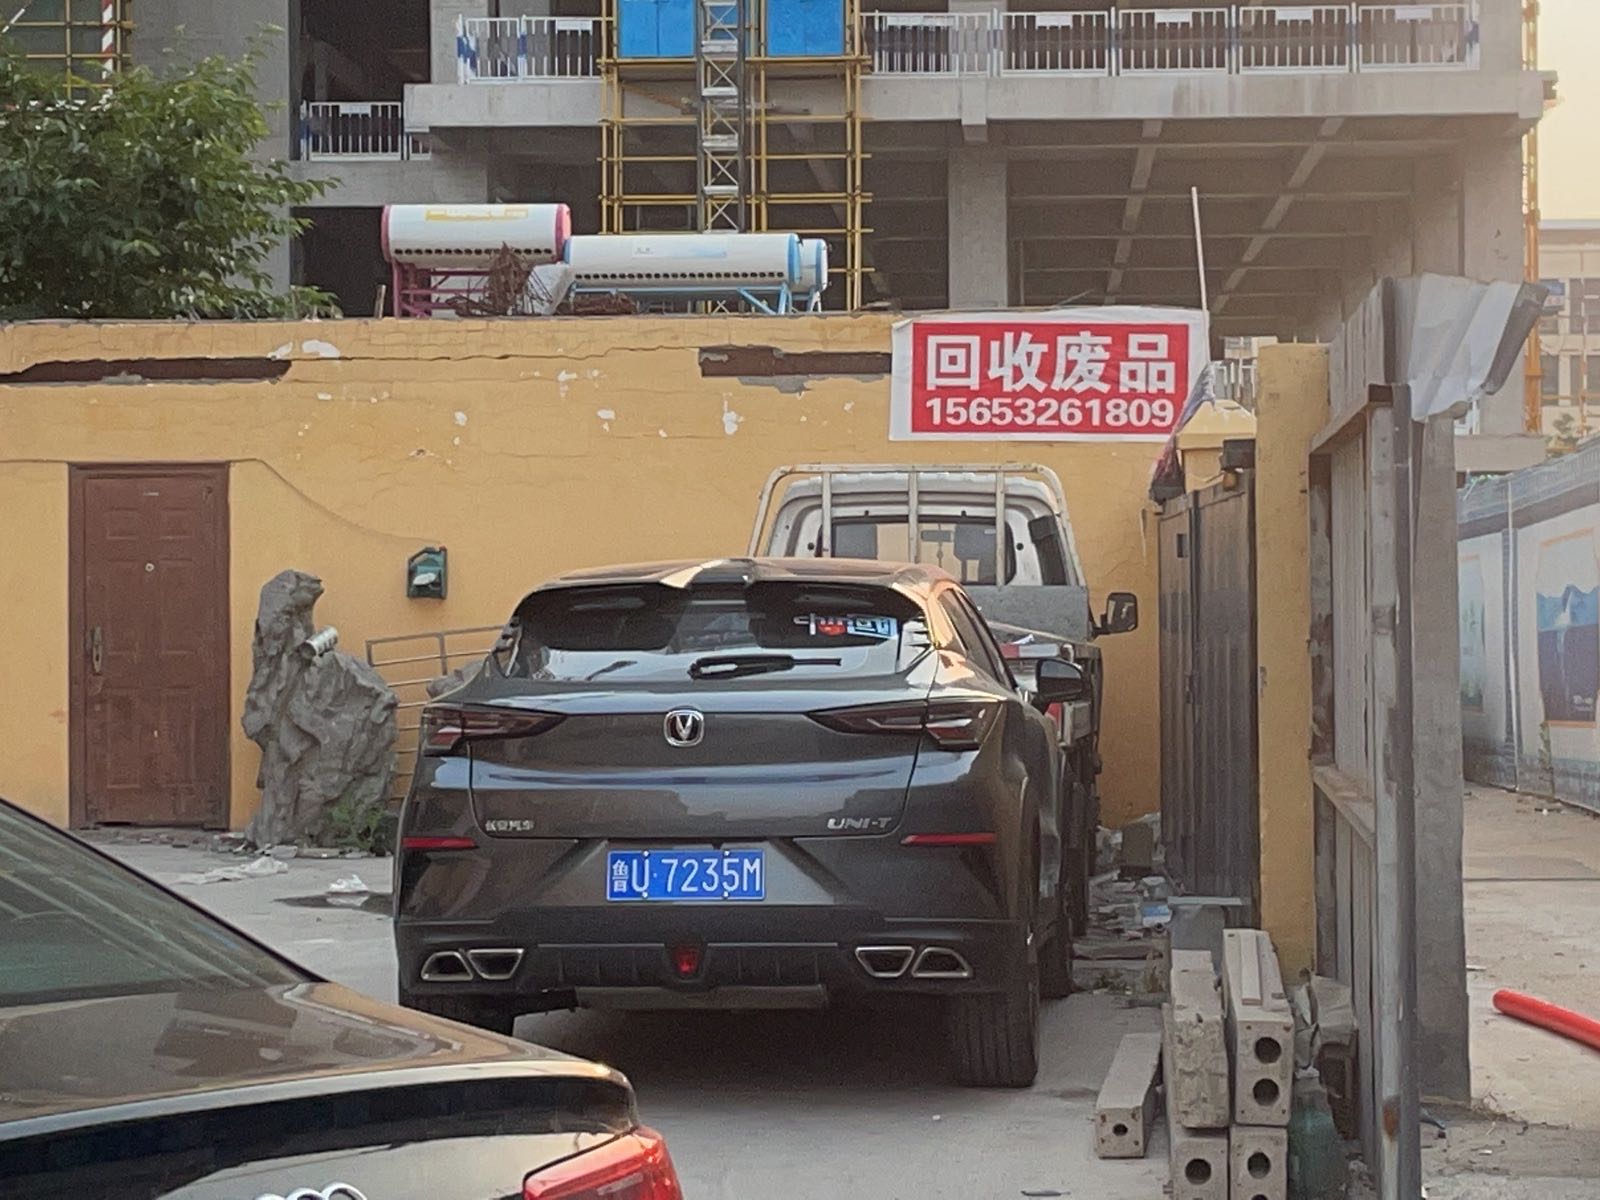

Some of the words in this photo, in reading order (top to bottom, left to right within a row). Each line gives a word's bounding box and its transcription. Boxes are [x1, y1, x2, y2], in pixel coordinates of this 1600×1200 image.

[926, 331, 1176, 394] 回收废品
[926, 397, 1174, 426] 15653261809
[827, 817, 892, 829] UNI-T
